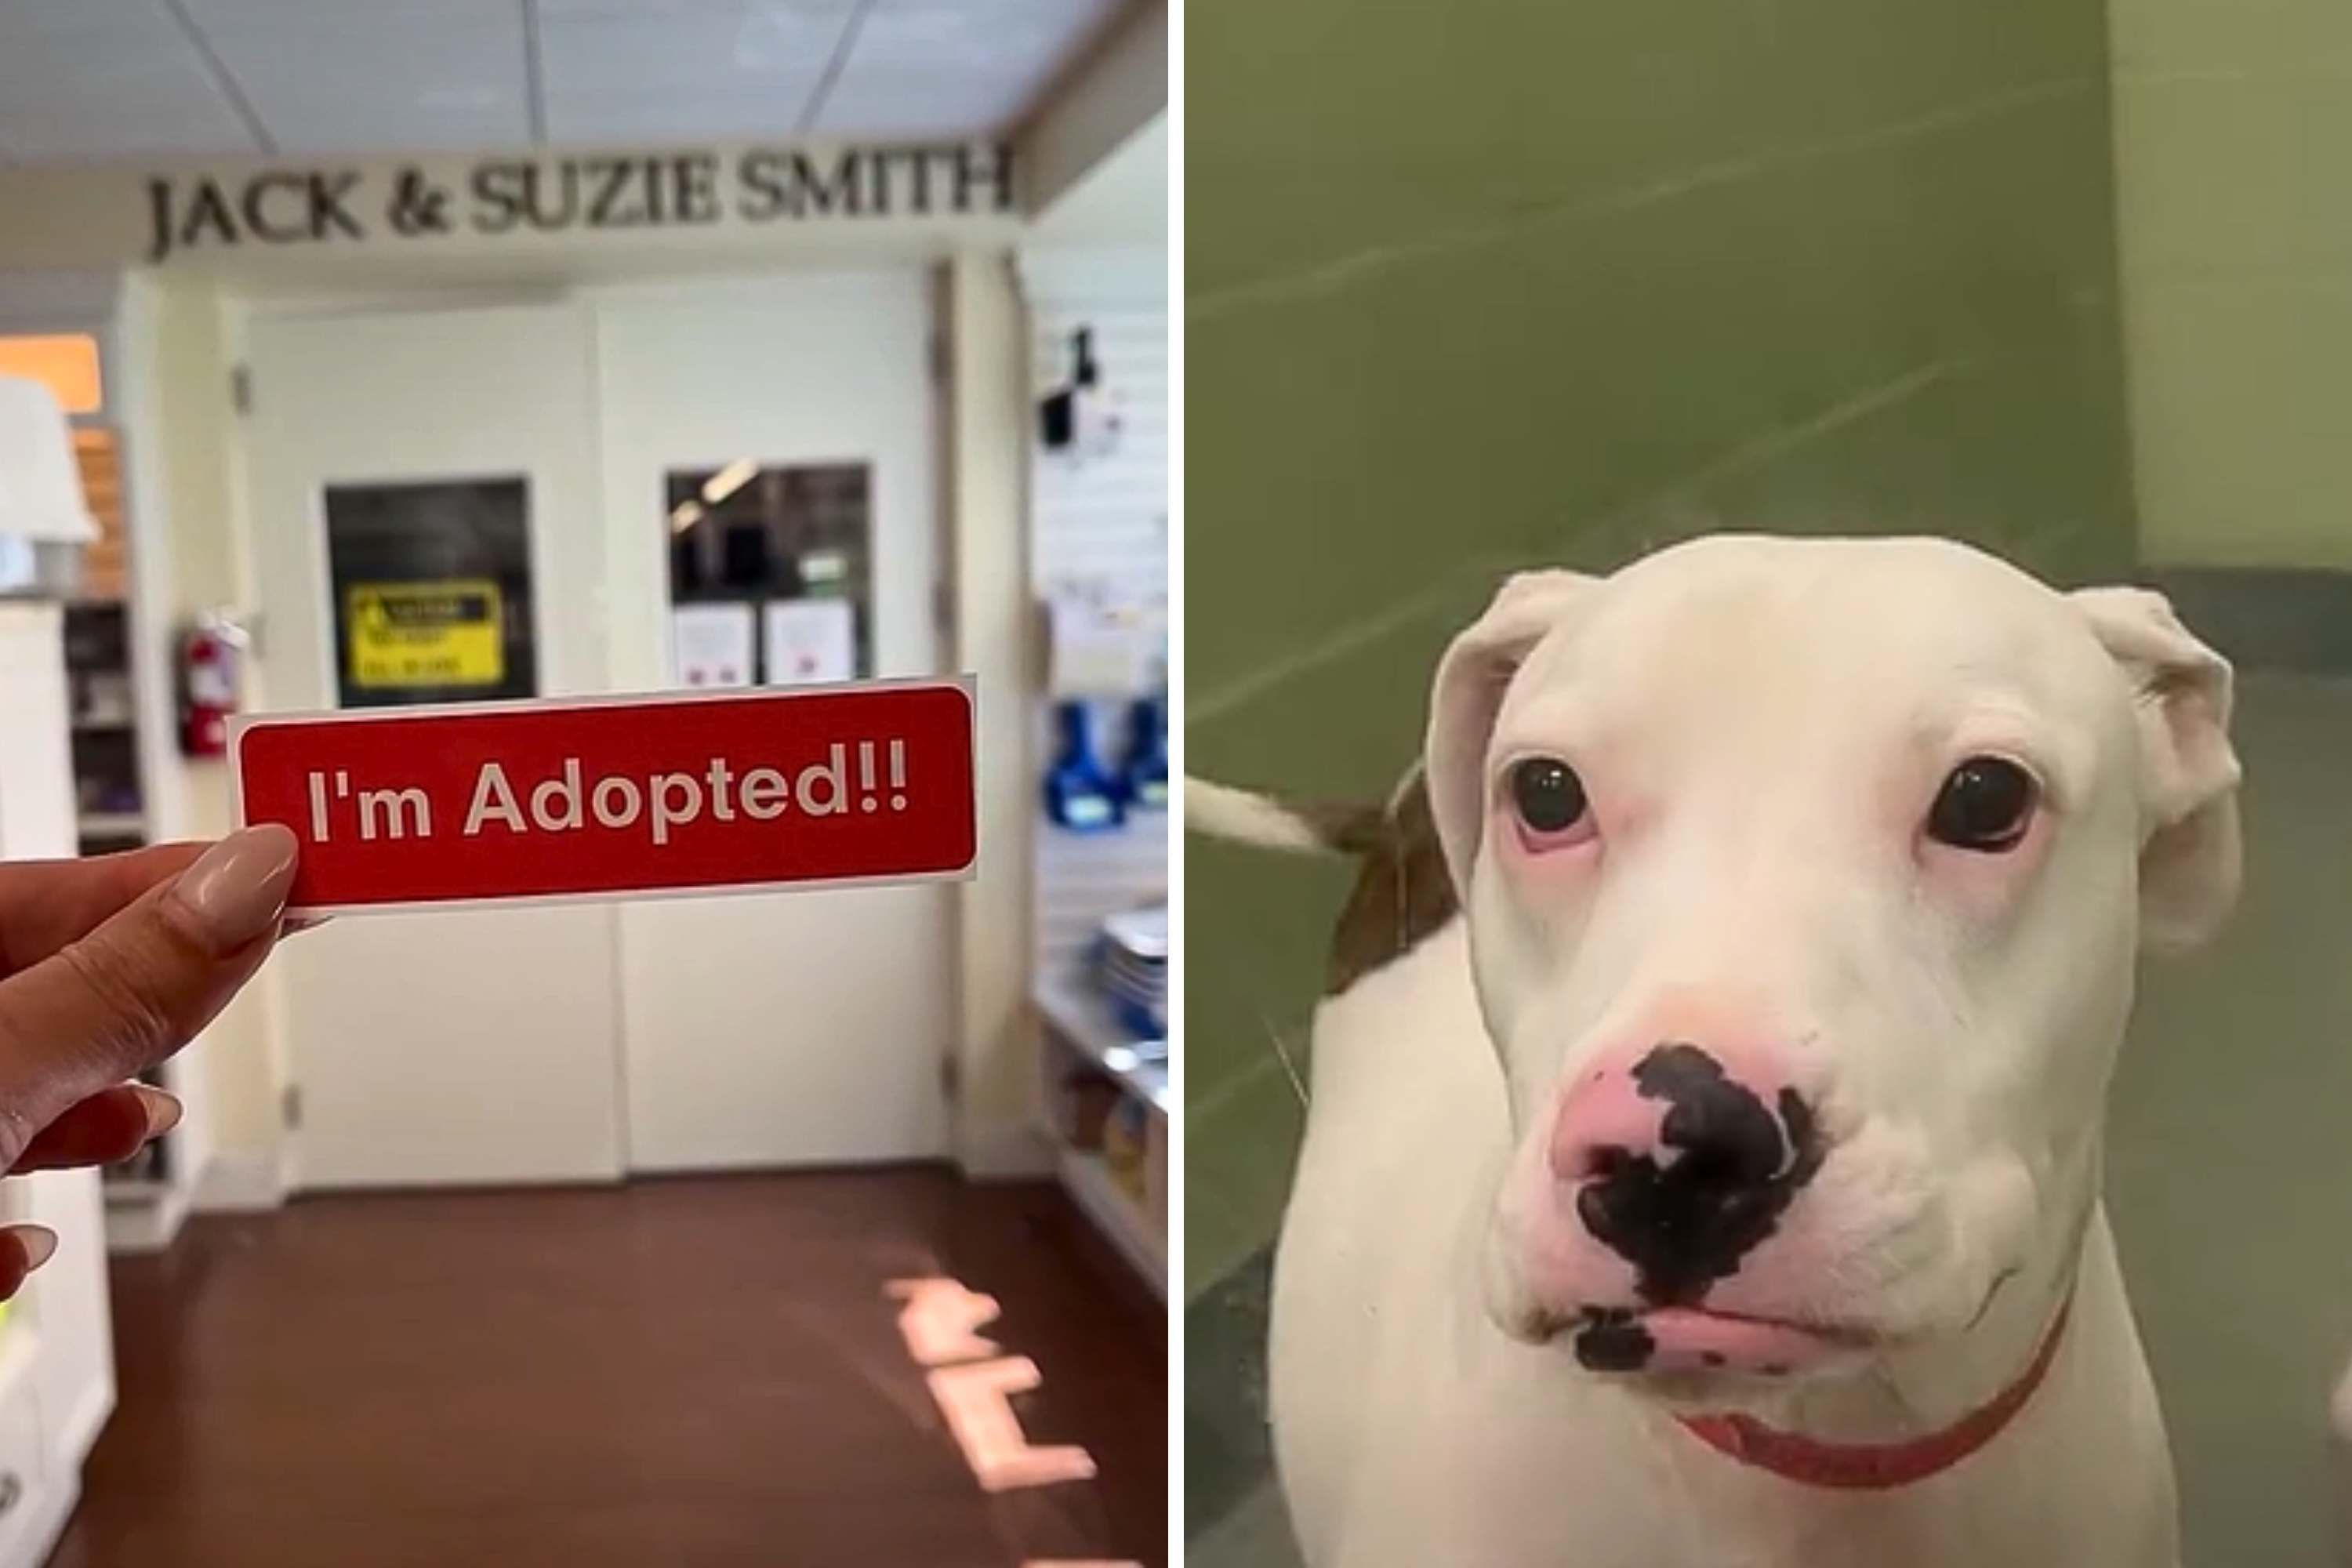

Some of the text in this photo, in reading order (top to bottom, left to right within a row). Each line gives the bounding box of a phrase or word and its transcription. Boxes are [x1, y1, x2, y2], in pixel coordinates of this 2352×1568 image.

[144, 145, 1016, 263] JACK & SUZIE SMITH
[309, 739, 909, 845] I'm Adopted!!
